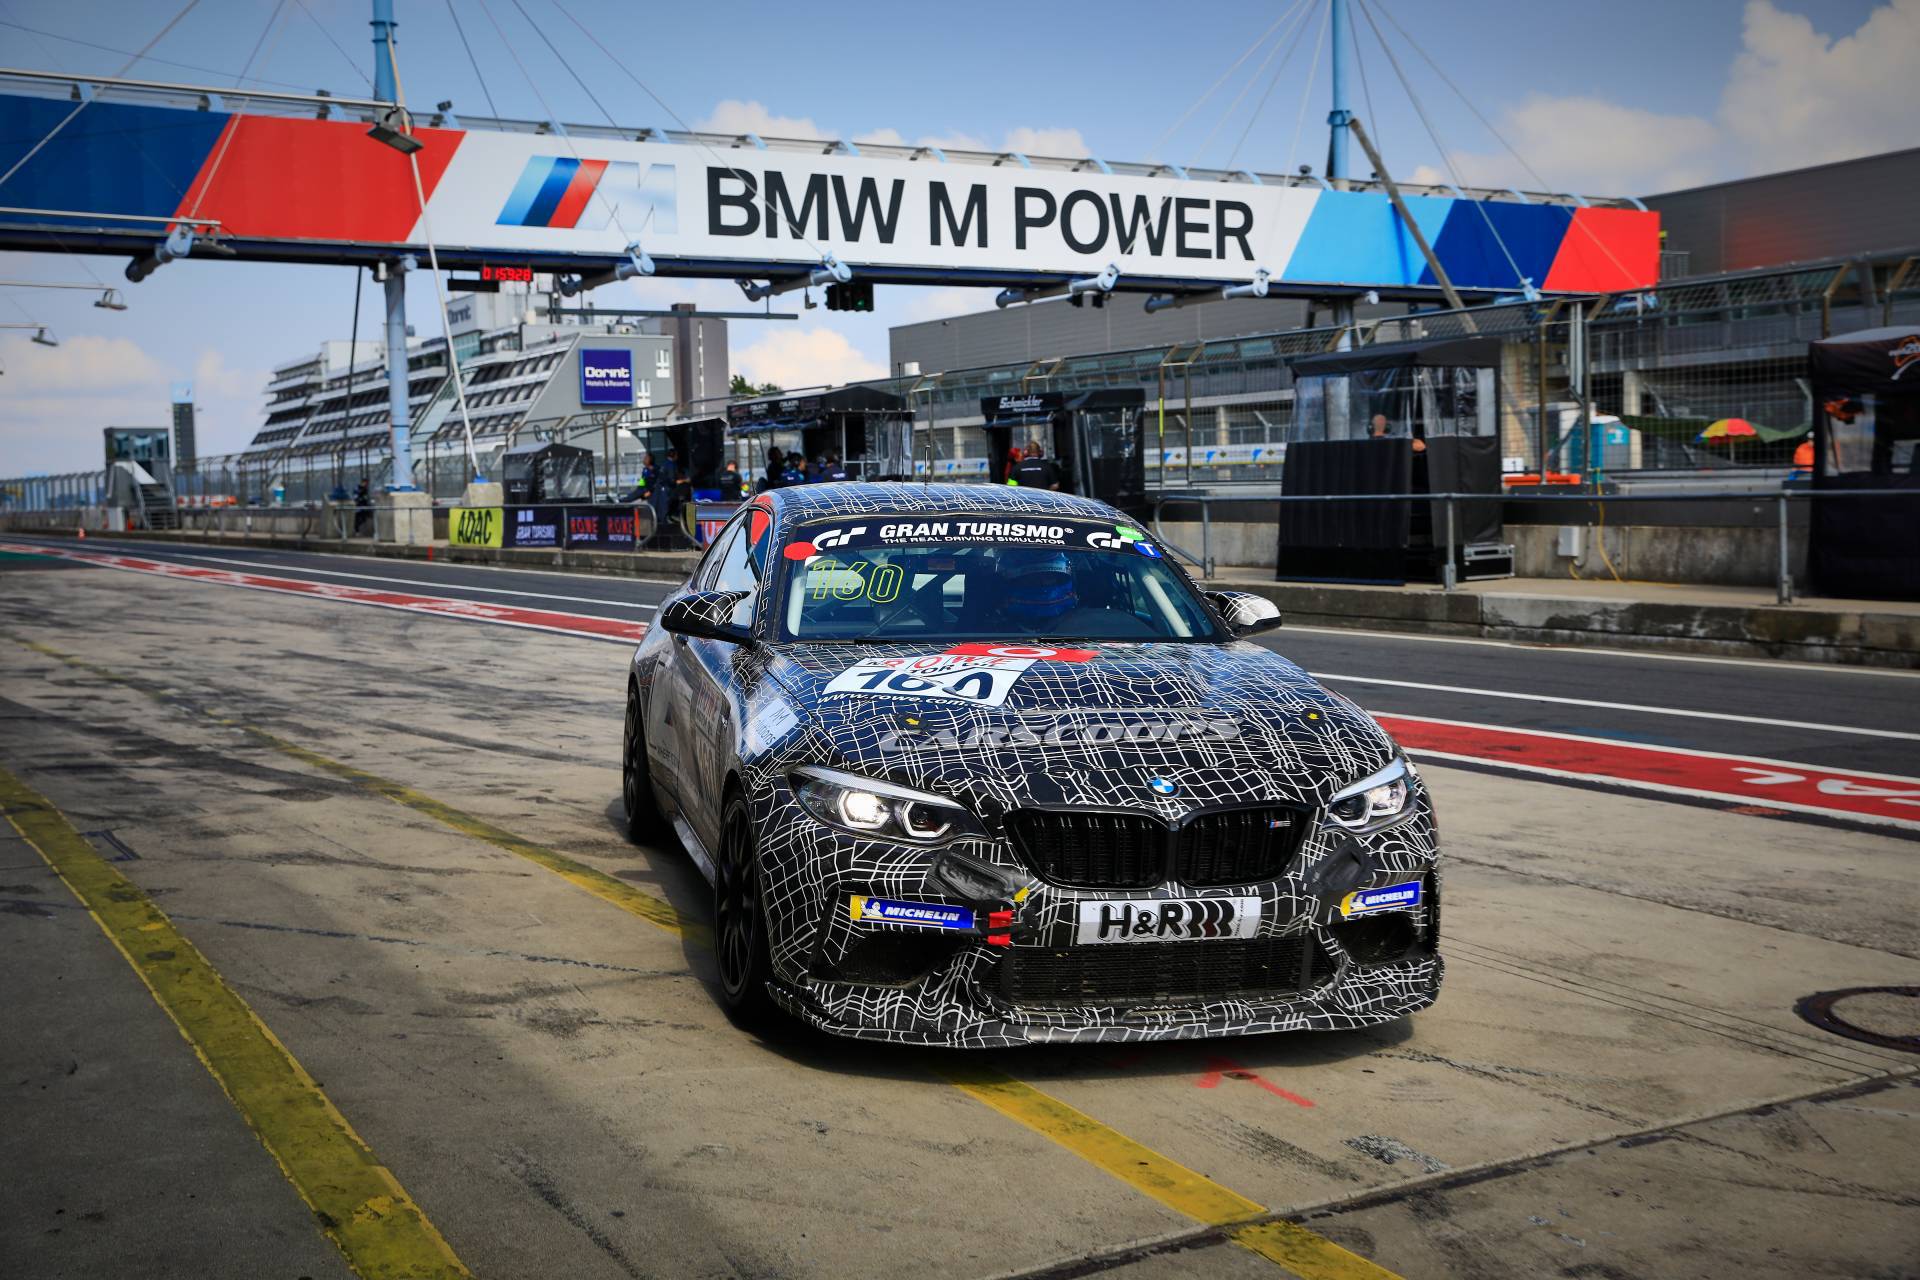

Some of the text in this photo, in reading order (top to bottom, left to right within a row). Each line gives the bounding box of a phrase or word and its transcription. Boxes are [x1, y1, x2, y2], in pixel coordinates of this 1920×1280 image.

[706, 166, 1256, 261] BMW M POWER
[458, 510, 493, 544] ADAC
[879, 523, 948, 538] GRAN
[997, 536, 1066, 545] SIMULATOR
[811, 559, 904, 603] 160
[857, 669, 994, 700] 160
[1365, 890, 1415, 905] MICHELIN
[884, 906, 960, 921] MICHELIN
